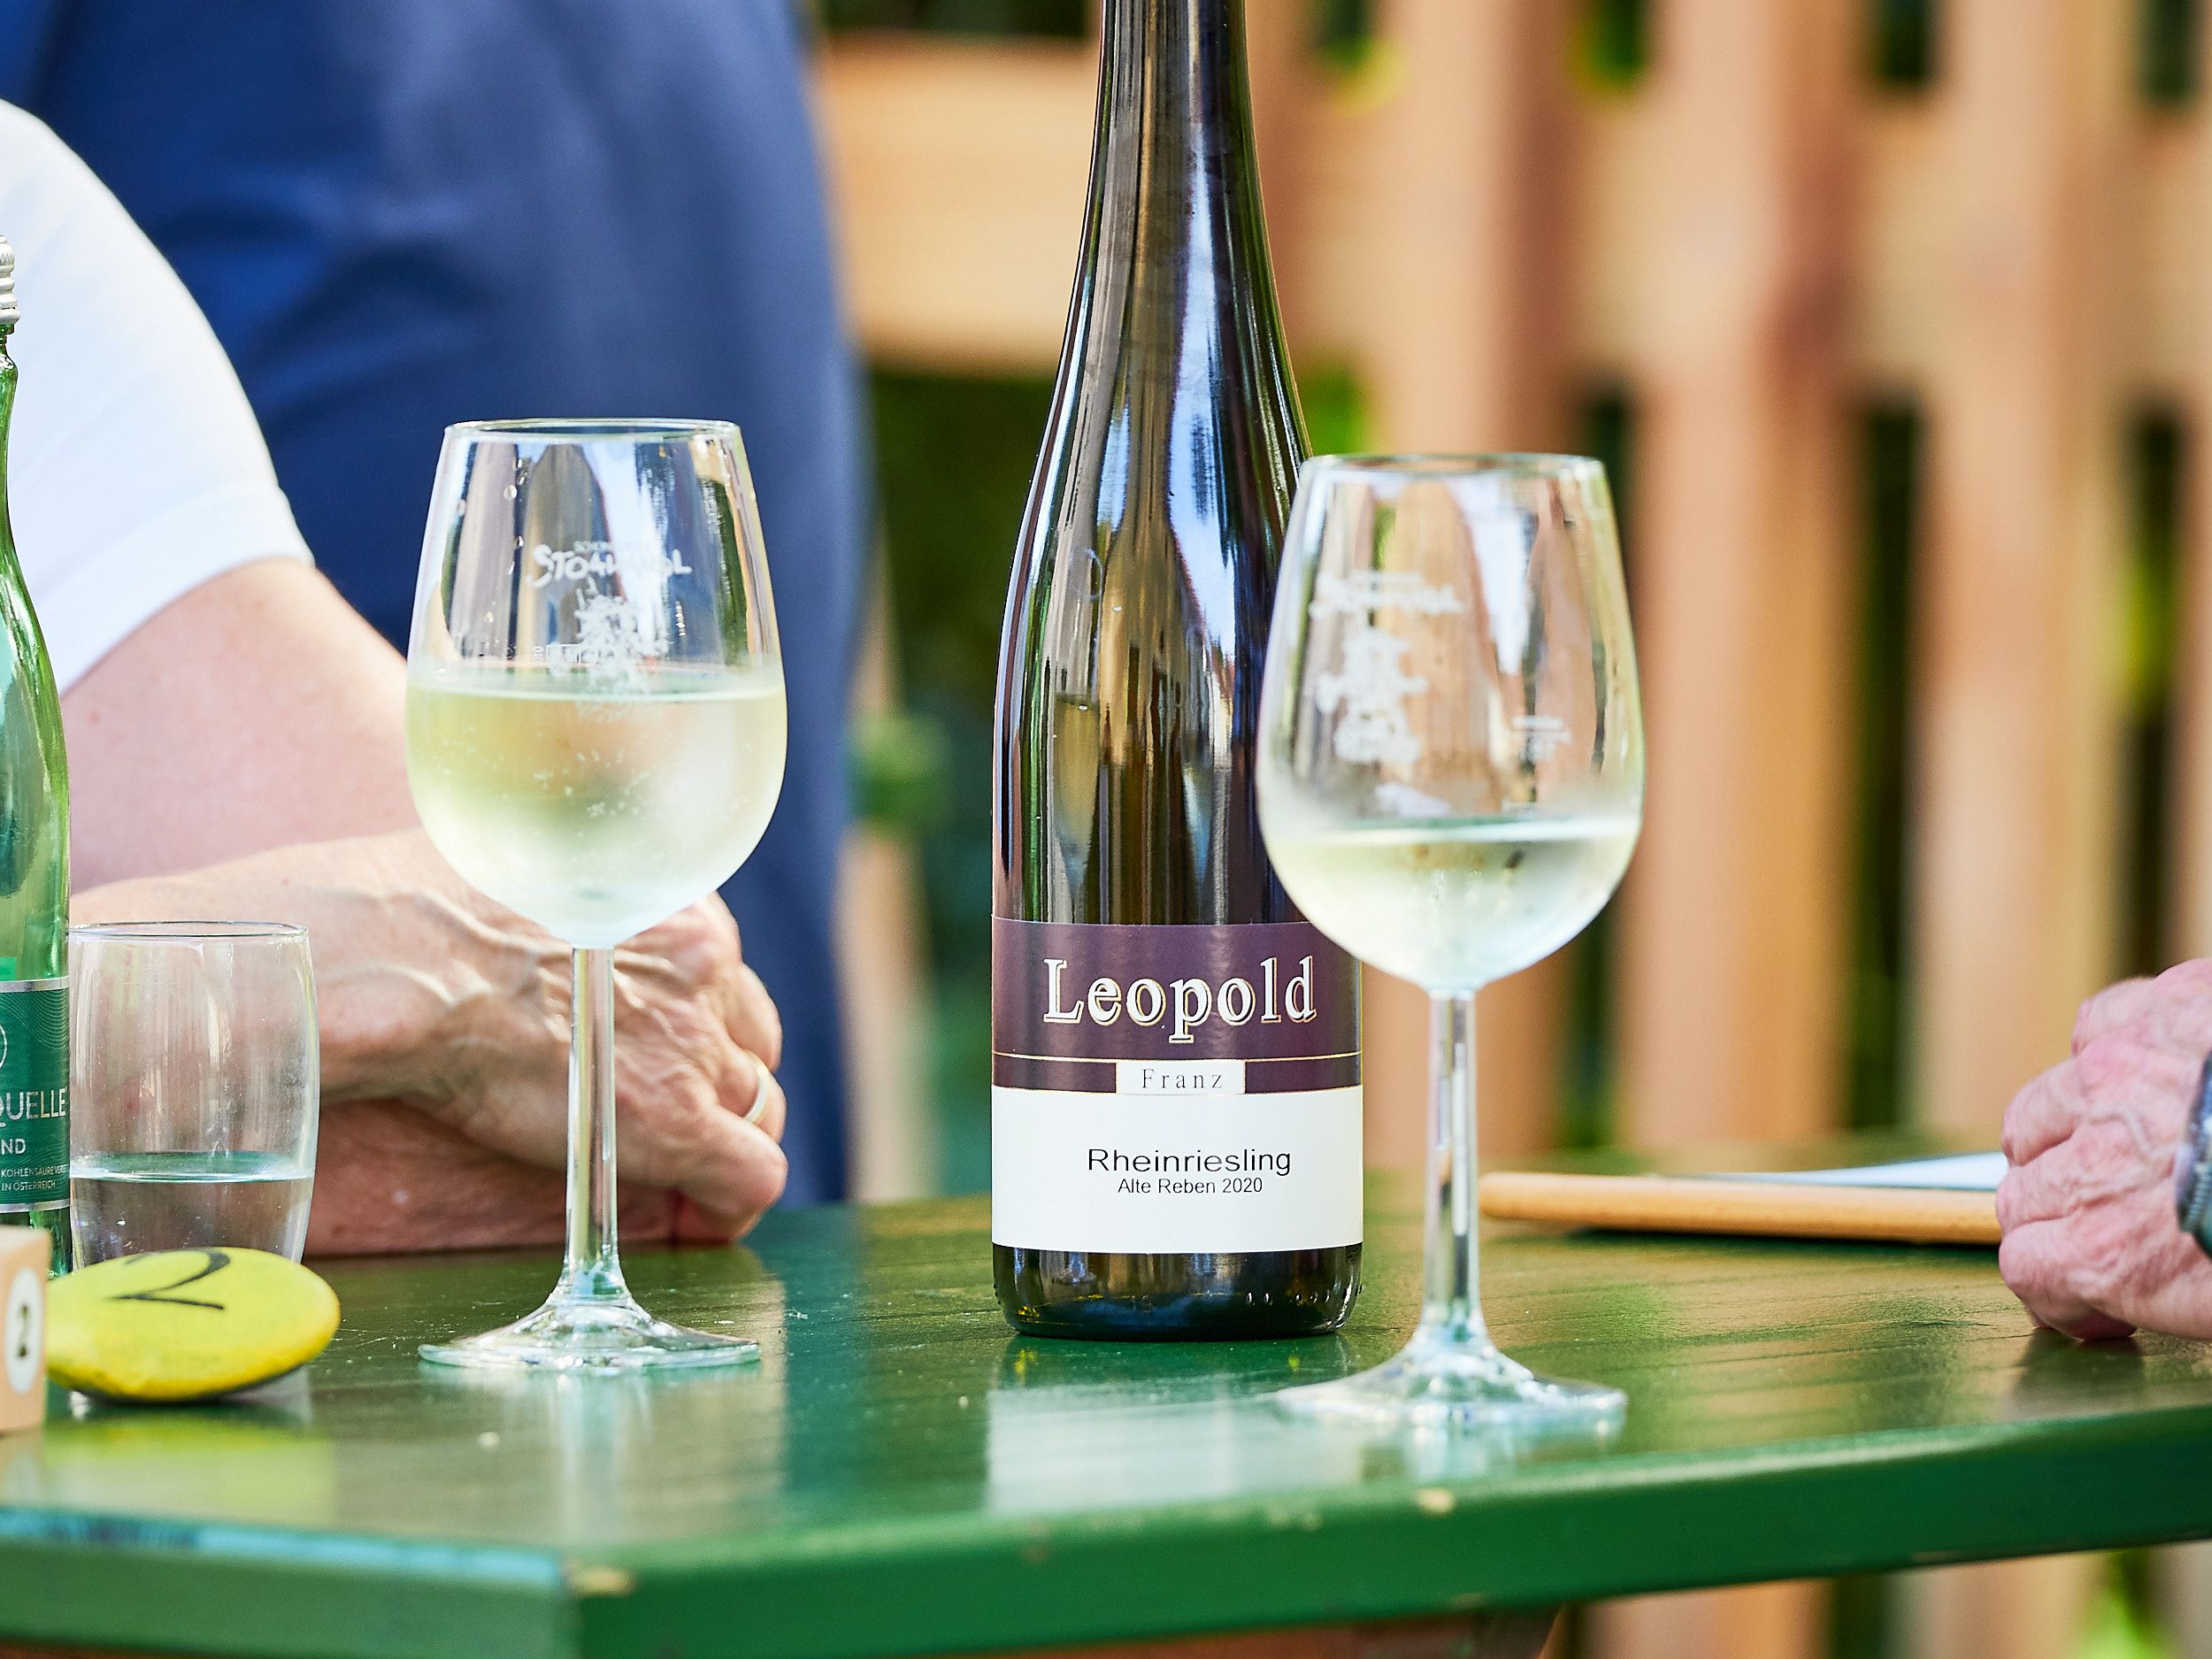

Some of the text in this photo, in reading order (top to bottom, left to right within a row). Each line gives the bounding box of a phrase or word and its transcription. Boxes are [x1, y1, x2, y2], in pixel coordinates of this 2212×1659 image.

[1043, 955, 1317, 1044] Leopold
[1141, 1068, 1223, 1089] Franz
[0, 1087, 67, 1127] UELLE
[1087, 1148, 1292, 1177] Rheinriesling
[1, 1182, 12, 1191] IN
[1118, 1177, 1263, 1194] Alte Reben 2020
[106, 1246, 231, 1310] 2
